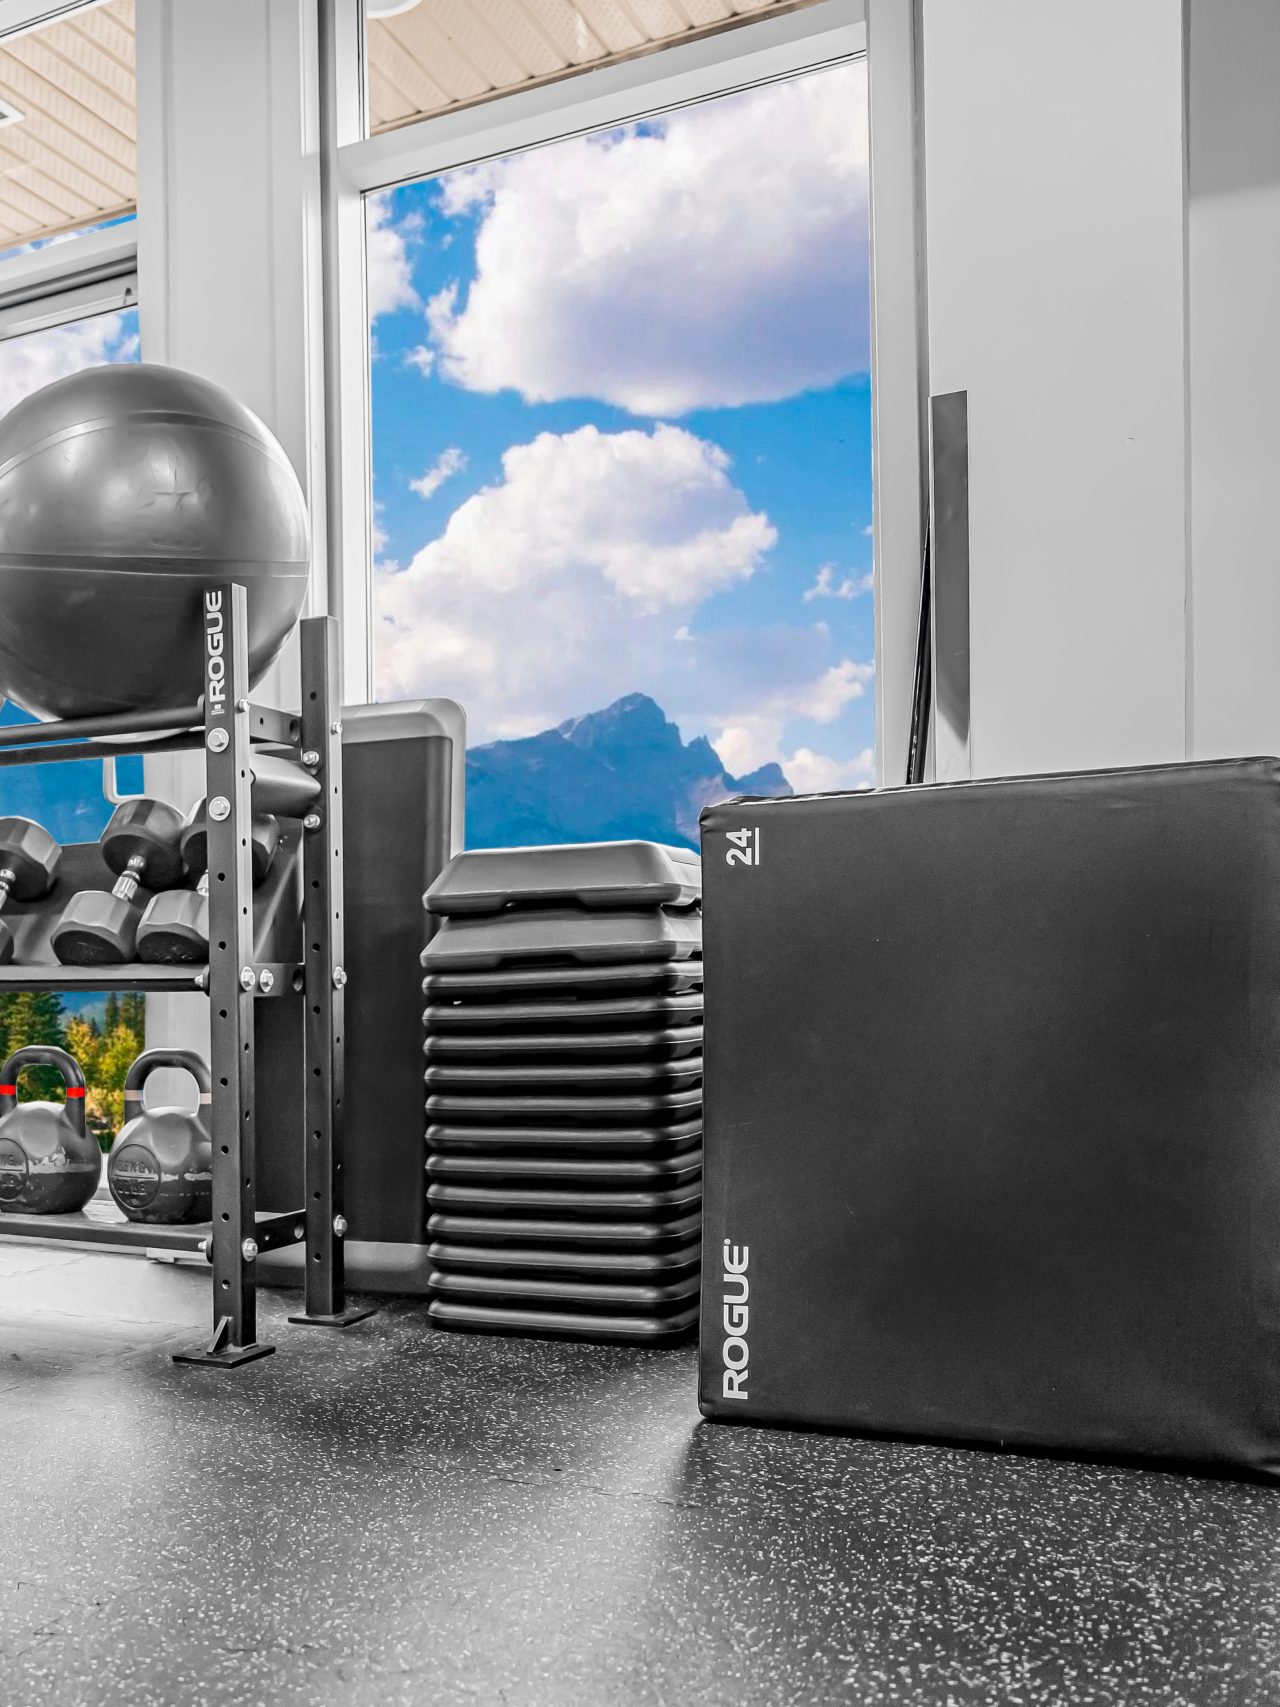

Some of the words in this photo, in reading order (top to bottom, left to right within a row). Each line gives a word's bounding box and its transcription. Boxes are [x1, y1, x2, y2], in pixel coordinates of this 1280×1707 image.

[206, 590, 226, 702] ROGUE
[726, 828, 752, 866] 24
[723, 1245, 750, 1400] ROGUE
